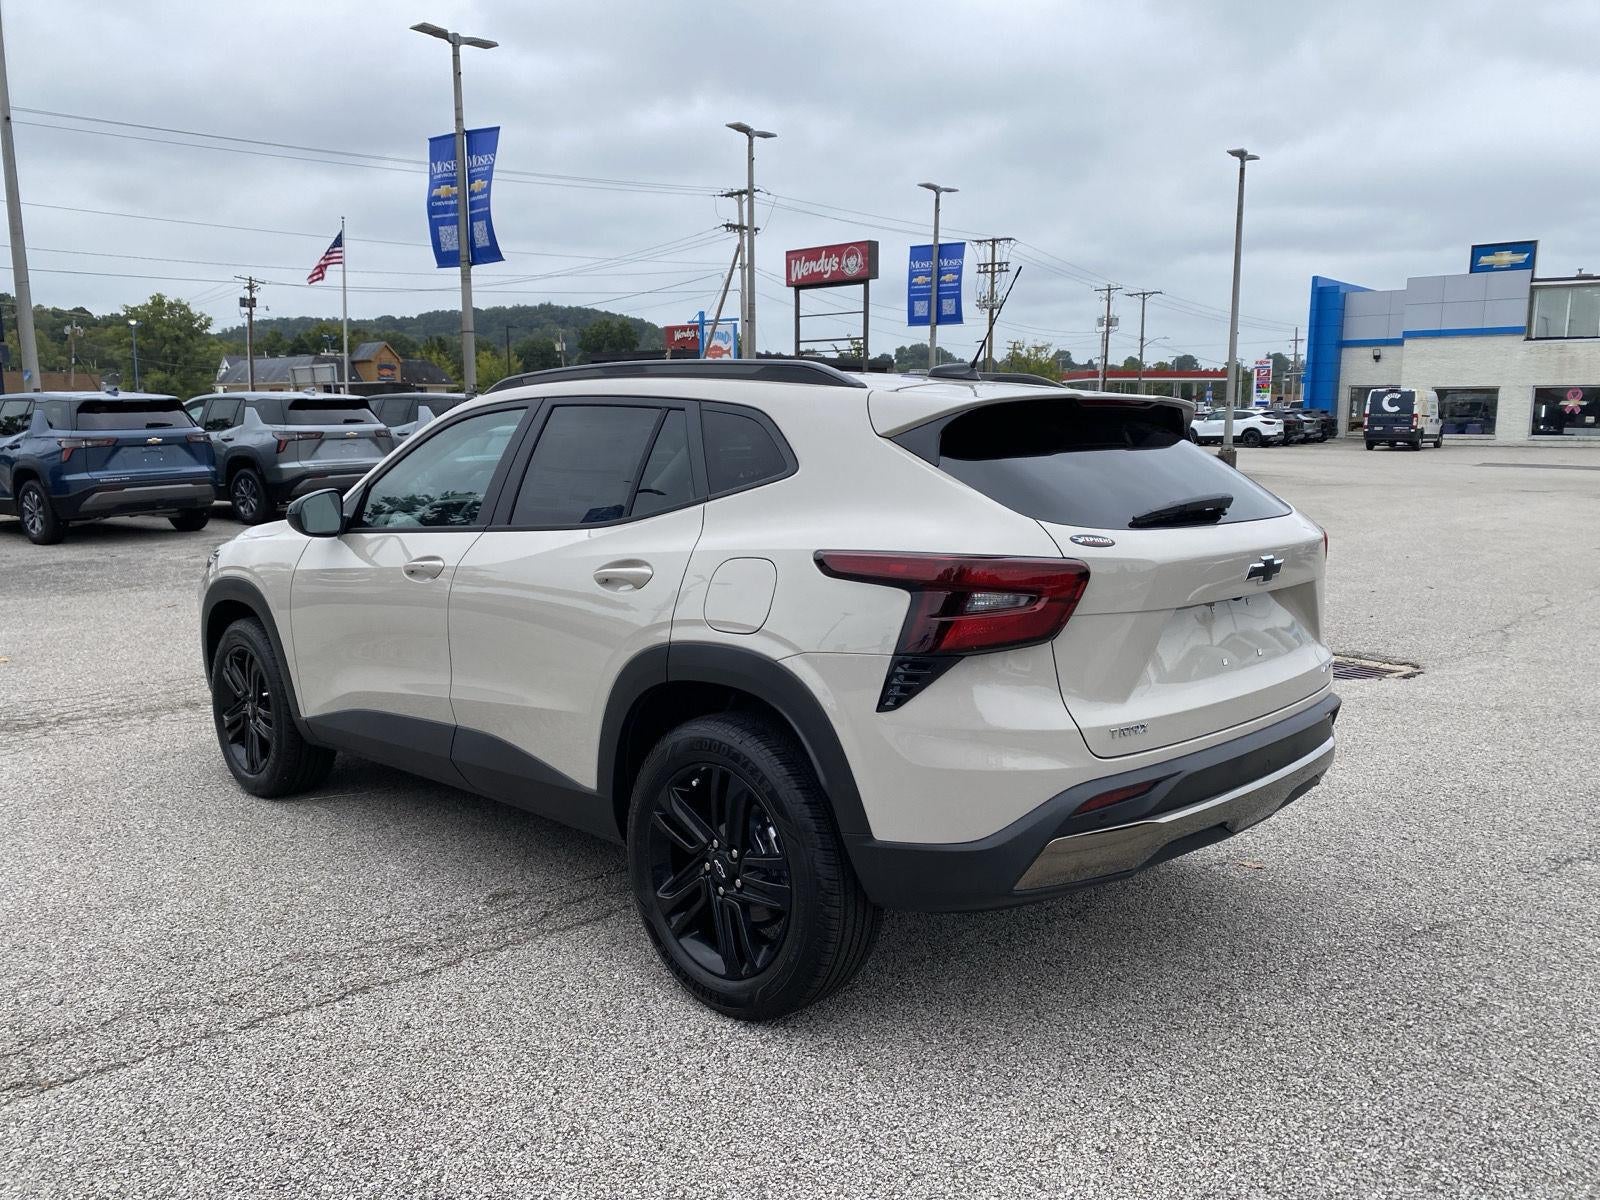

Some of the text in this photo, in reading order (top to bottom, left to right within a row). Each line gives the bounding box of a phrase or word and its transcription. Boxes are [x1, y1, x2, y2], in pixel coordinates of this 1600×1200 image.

[431, 160, 457, 174] MOSE
[468, 153, 495, 168] MOSES
[791, 250, 839, 282] Wendy's
[939, 258, 963, 267] MOSES
[674, 327, 695, 341] Wendy's
[1071, 536, 1113, 544] STEPHENS
[1109, 722, 1149, 739] TRAX
